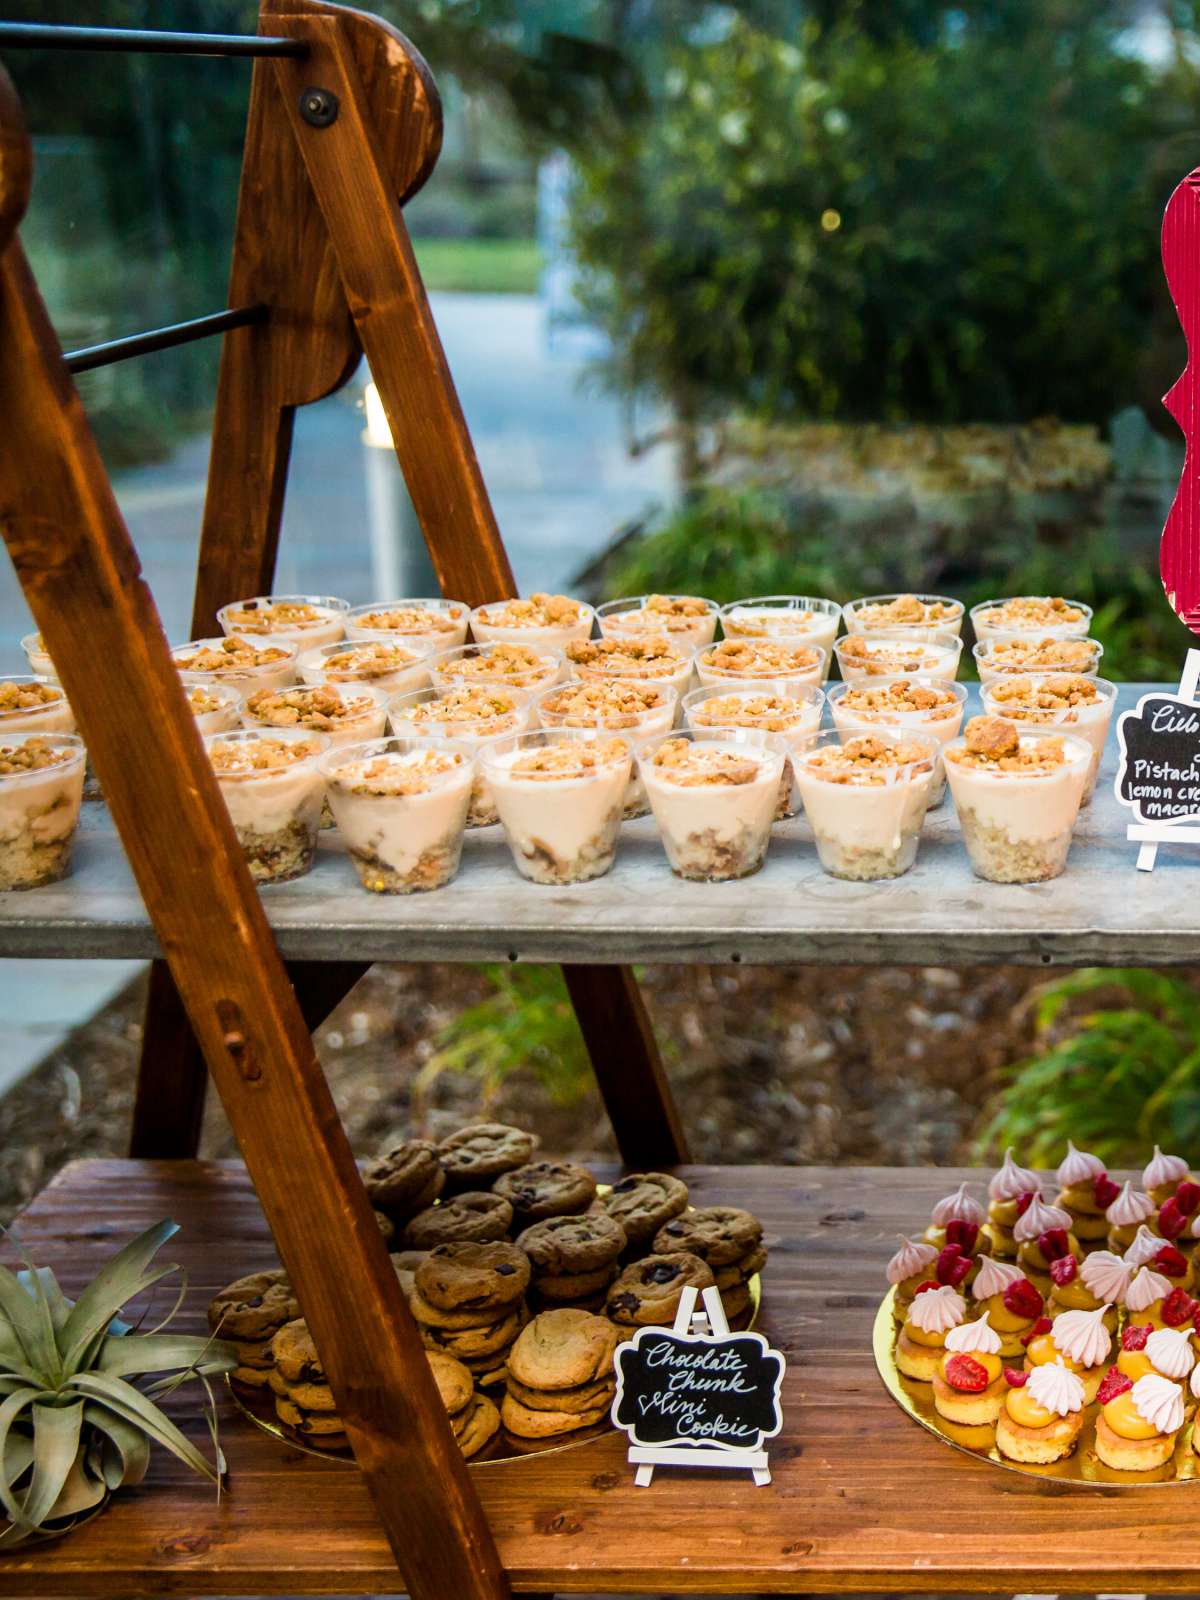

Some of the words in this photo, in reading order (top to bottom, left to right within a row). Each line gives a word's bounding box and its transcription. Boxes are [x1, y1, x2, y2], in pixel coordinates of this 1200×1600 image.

[1151, 705, 1200, 734] Cielo
[1128, 781, 1172, 800] lemon
[647, 1342, 748, 1371] Chocolate
[668, 1371, 758, 1392] Chunk
[638, 1391, 707, 1415] Mini
[676, 1414, 759, 1437] Cookie
